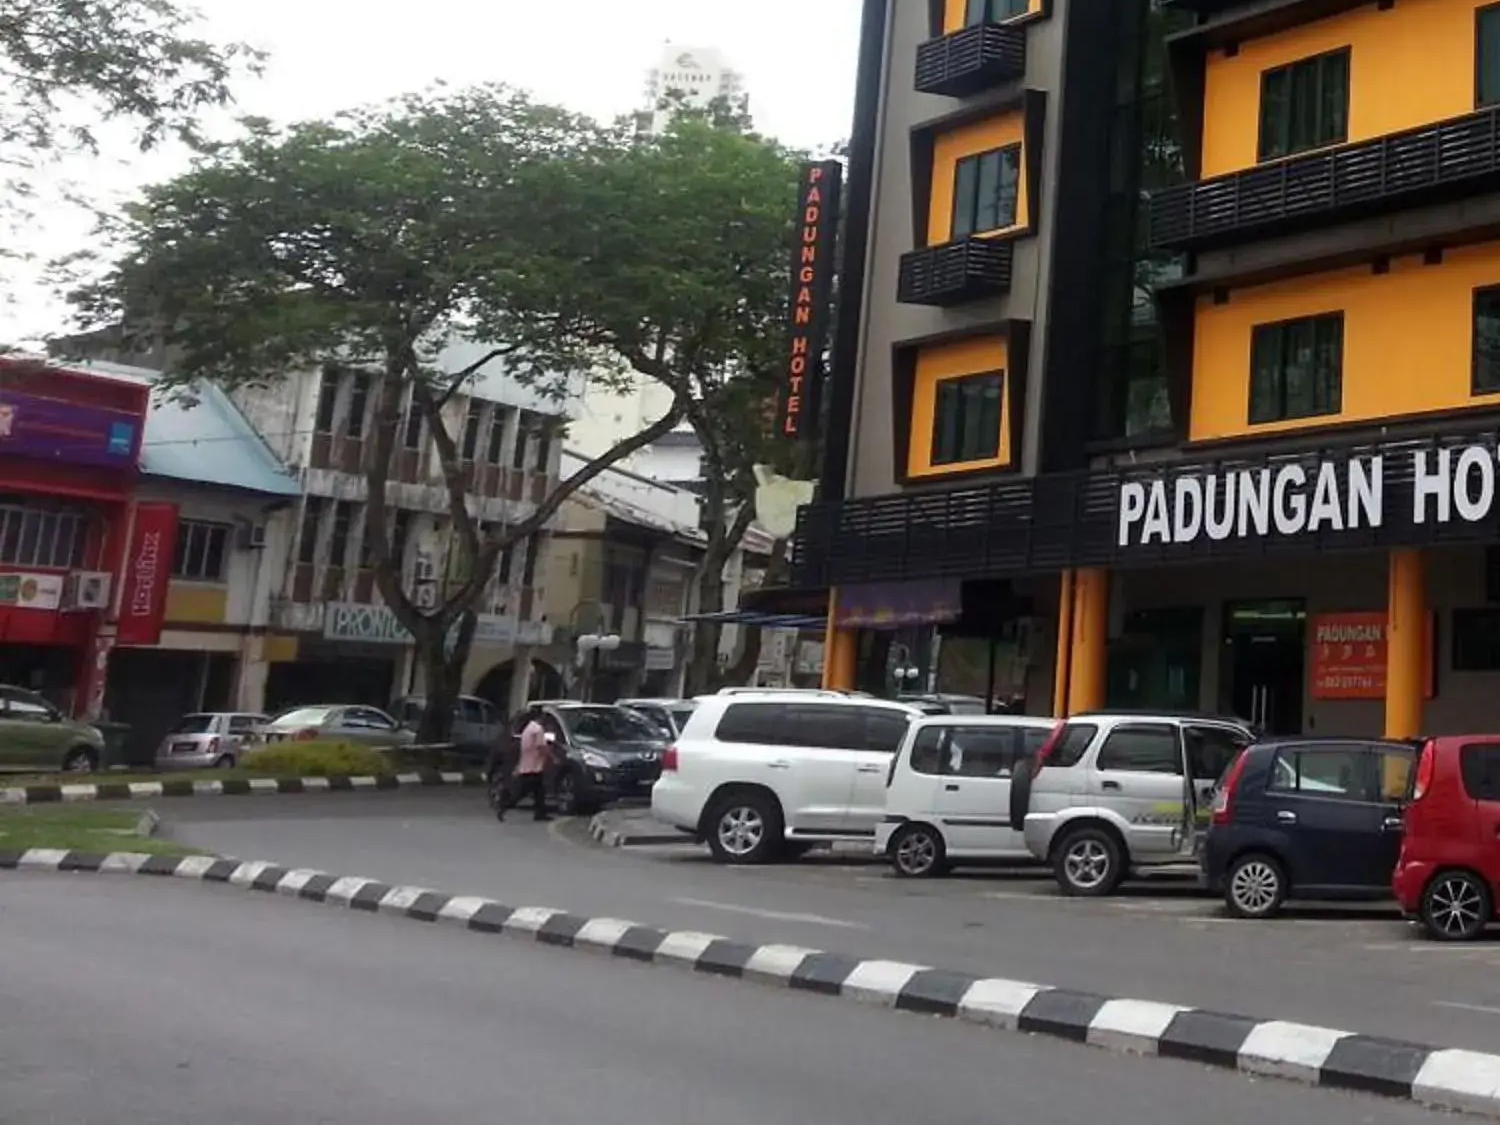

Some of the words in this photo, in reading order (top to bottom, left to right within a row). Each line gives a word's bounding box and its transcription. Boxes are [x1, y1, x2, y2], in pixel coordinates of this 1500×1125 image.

[796, 168, 822, 323] PADUNGAN
[784, 336, 807, 433] HOTEL
[1118, 456, 1383, 546] PADUNGAN
[1316, 623, 1380, 642] PADUNGAN
